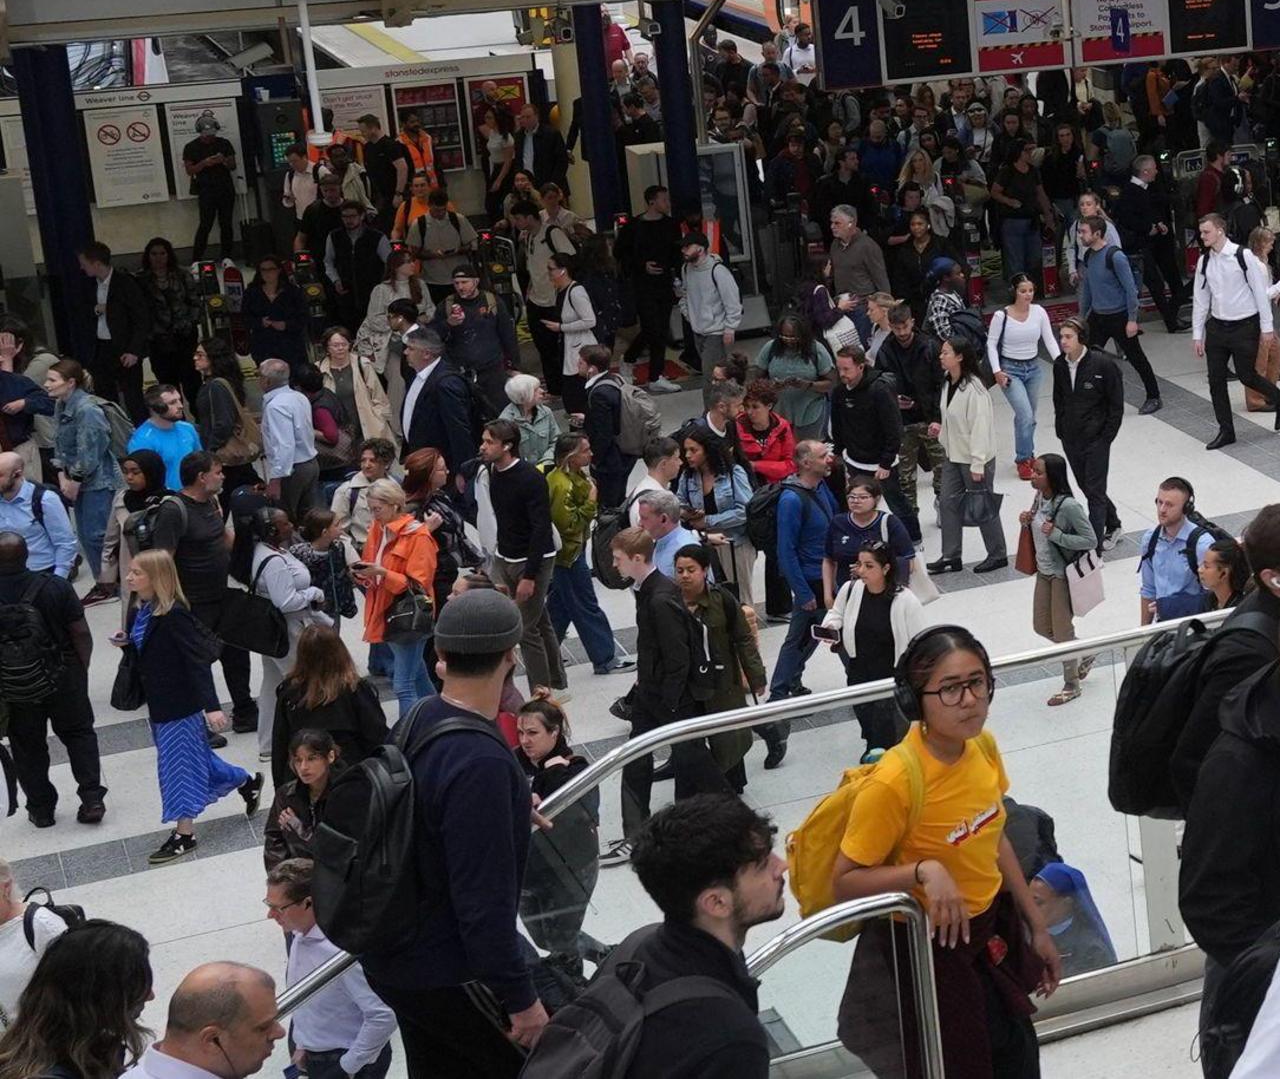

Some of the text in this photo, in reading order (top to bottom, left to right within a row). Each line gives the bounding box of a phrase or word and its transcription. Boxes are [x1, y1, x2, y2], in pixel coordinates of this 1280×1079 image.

[834, 5, 866, 47] 4
[1115, 17, 1125, 43] 4
[384, 63, 461, 79] stanstedexpress
[85, 94, 135, 105] Weaver line
